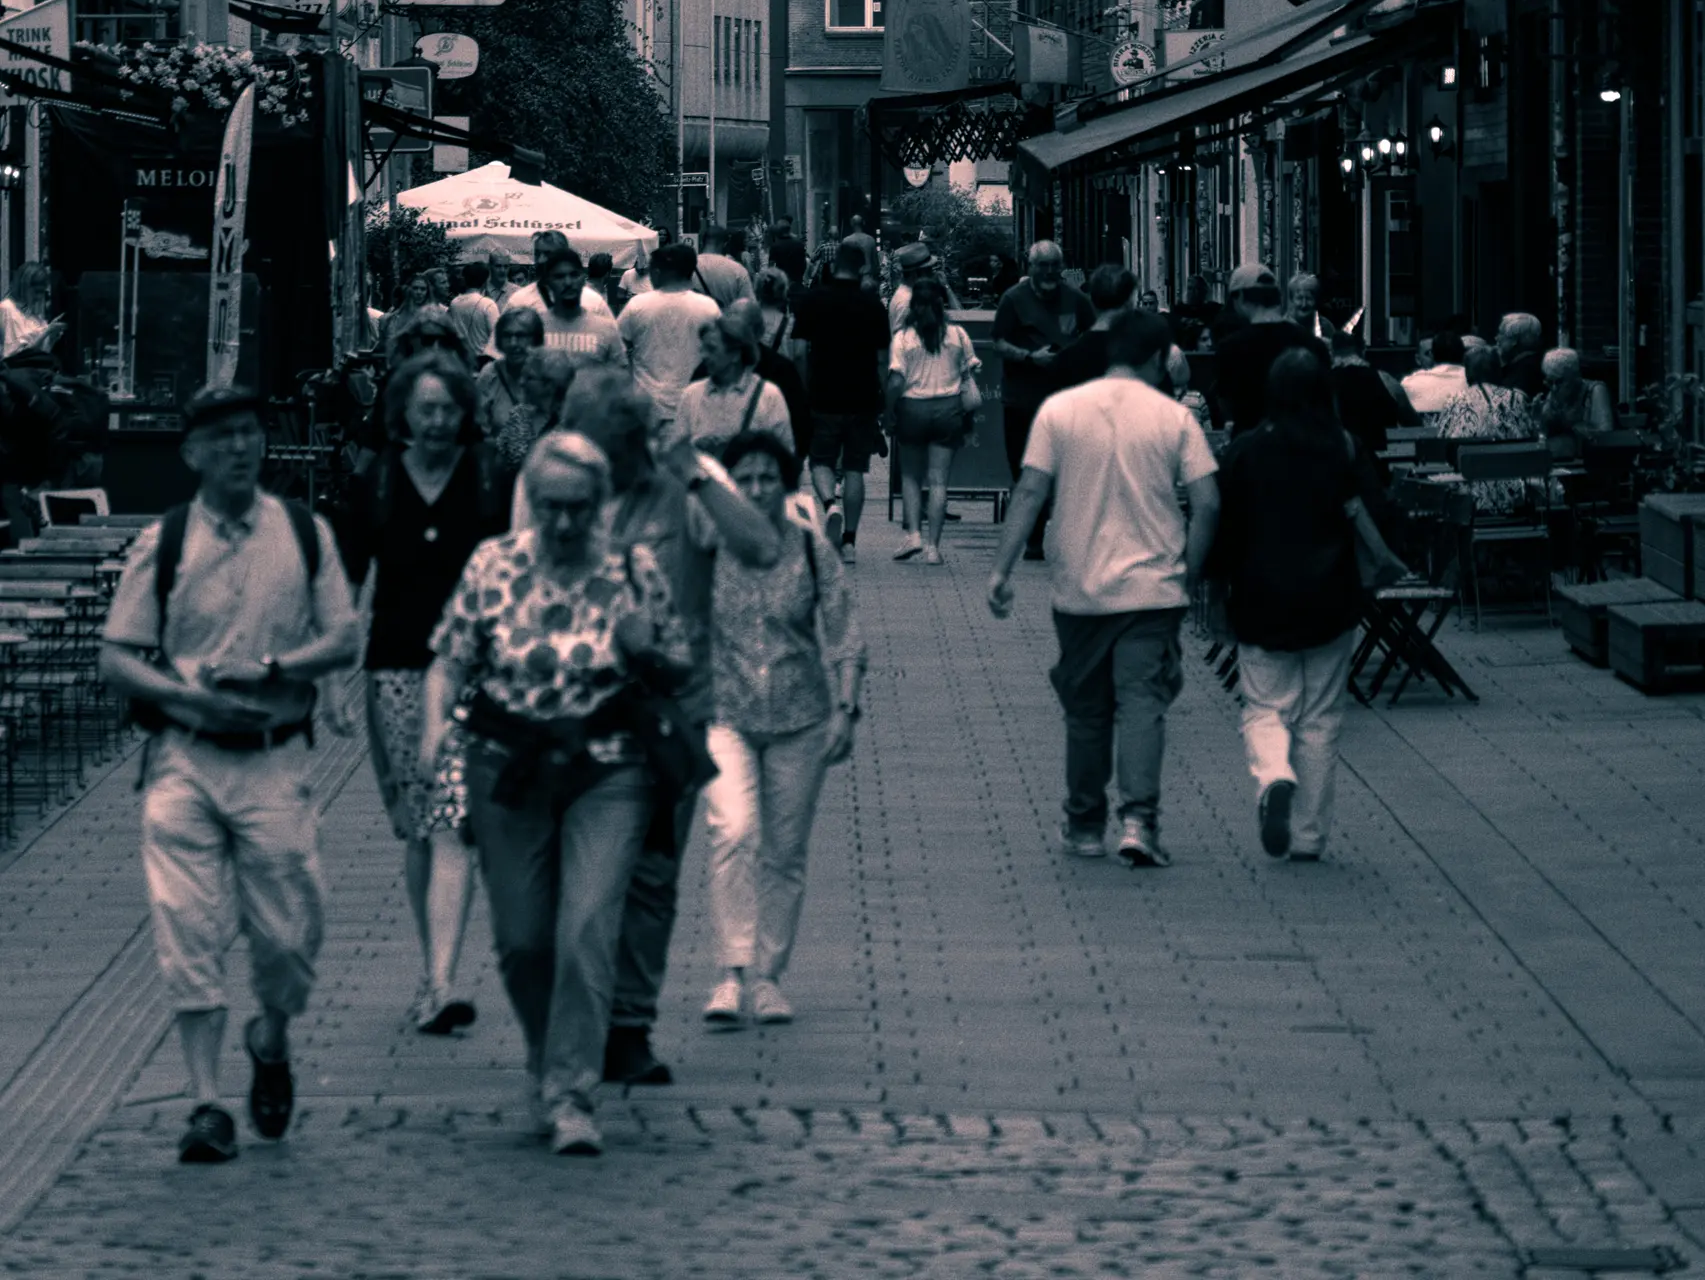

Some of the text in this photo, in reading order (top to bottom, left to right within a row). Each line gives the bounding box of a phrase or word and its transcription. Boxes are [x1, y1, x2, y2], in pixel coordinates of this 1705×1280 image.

[6, 26, 52, 43] TRINK
[1188, 33, 1217, 56] IZZERIA
[1113, 45, 1131, 68] BIRRA
[482, 214, 583, 229] Schlüssel
